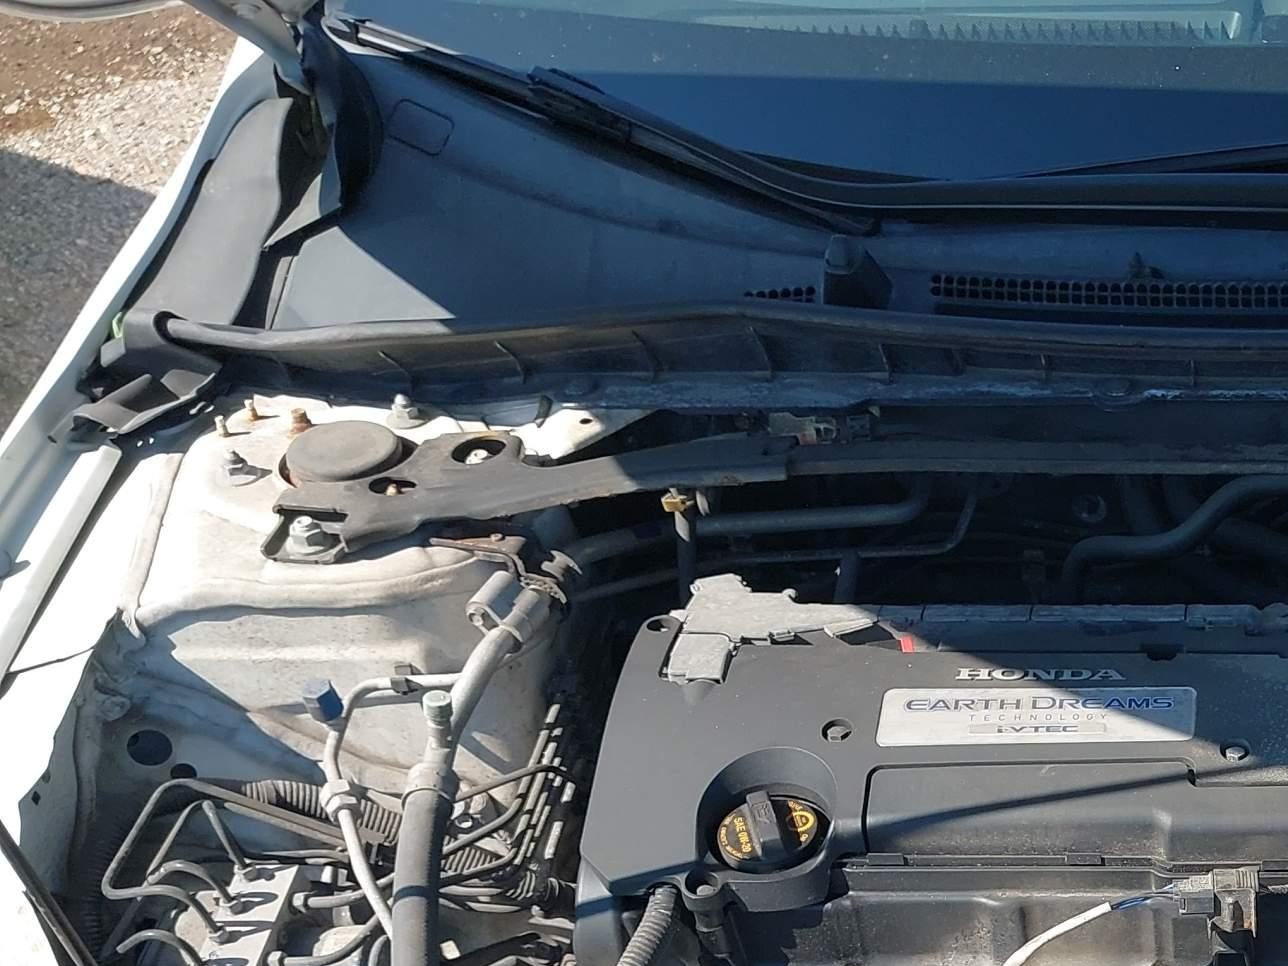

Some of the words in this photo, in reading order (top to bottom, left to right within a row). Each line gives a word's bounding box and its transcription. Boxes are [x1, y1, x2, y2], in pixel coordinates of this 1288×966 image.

[955, 668, 1125, 681] HONDA
[904, 697, 1022, 712] EARTH
[1031, 695, 1177, 711] DREAMS
[969, 713, 1109, 722] TECHNOLOGY
[734, 817, 746, 832] SAE
